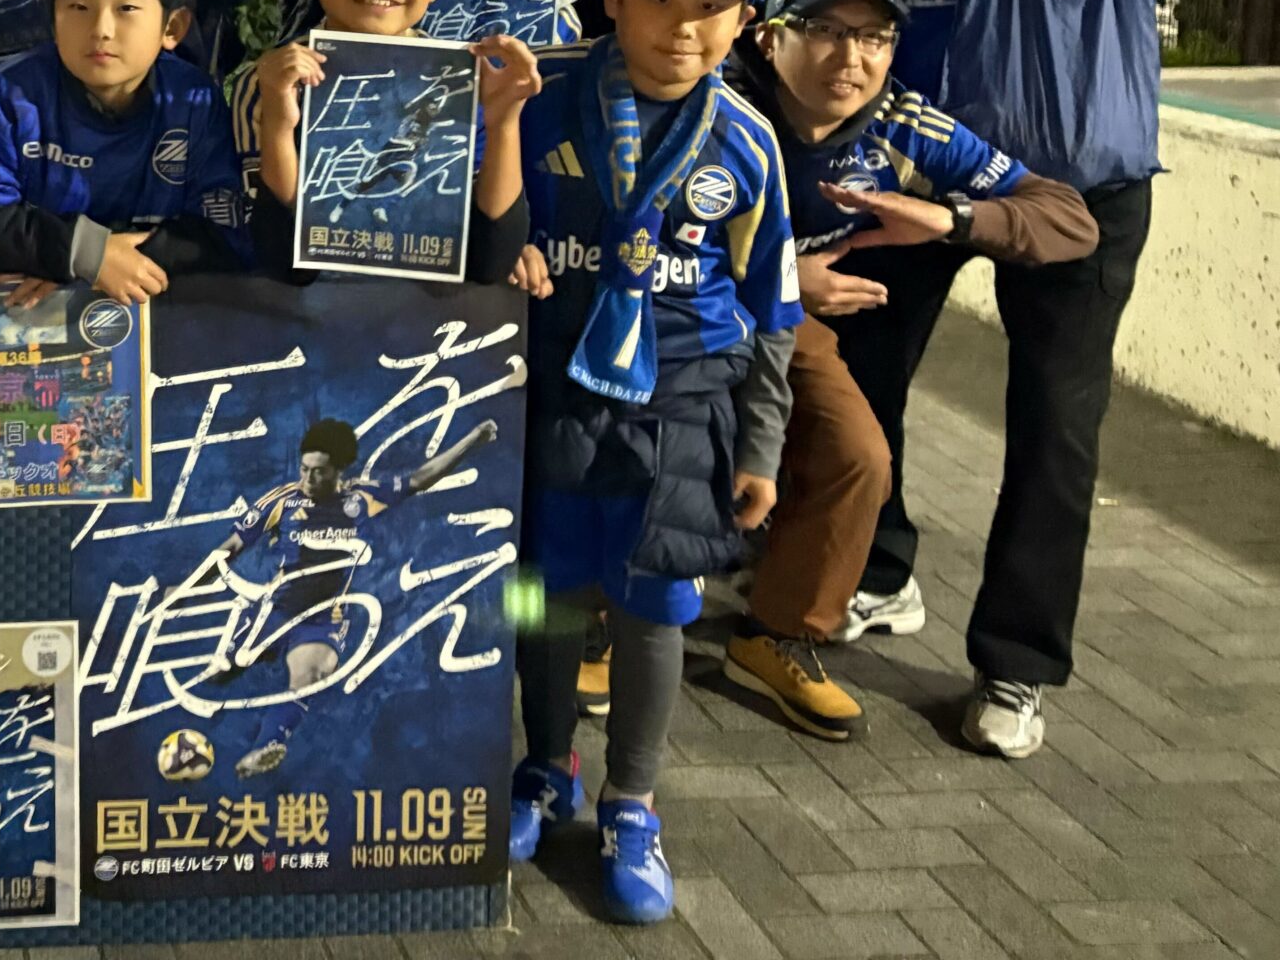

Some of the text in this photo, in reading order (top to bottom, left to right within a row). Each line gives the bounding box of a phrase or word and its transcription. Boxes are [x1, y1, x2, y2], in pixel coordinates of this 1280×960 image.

[306, 66, 475, 136] 圧を
[303, 134, 469, 204] 喰らえ
[308, 226, 440, 256] 国立決戦 11.09
[78, 506, 518, 738] 喰らえ
[95, 787, 458, 854] 国立決戦 11.09
[463, 786, 488, 840] SUN
[121, 851, 330, 876] FC町田ゼルビア VS FC東京
[351, 842, 487, 869] 14:00 KICK OFF
